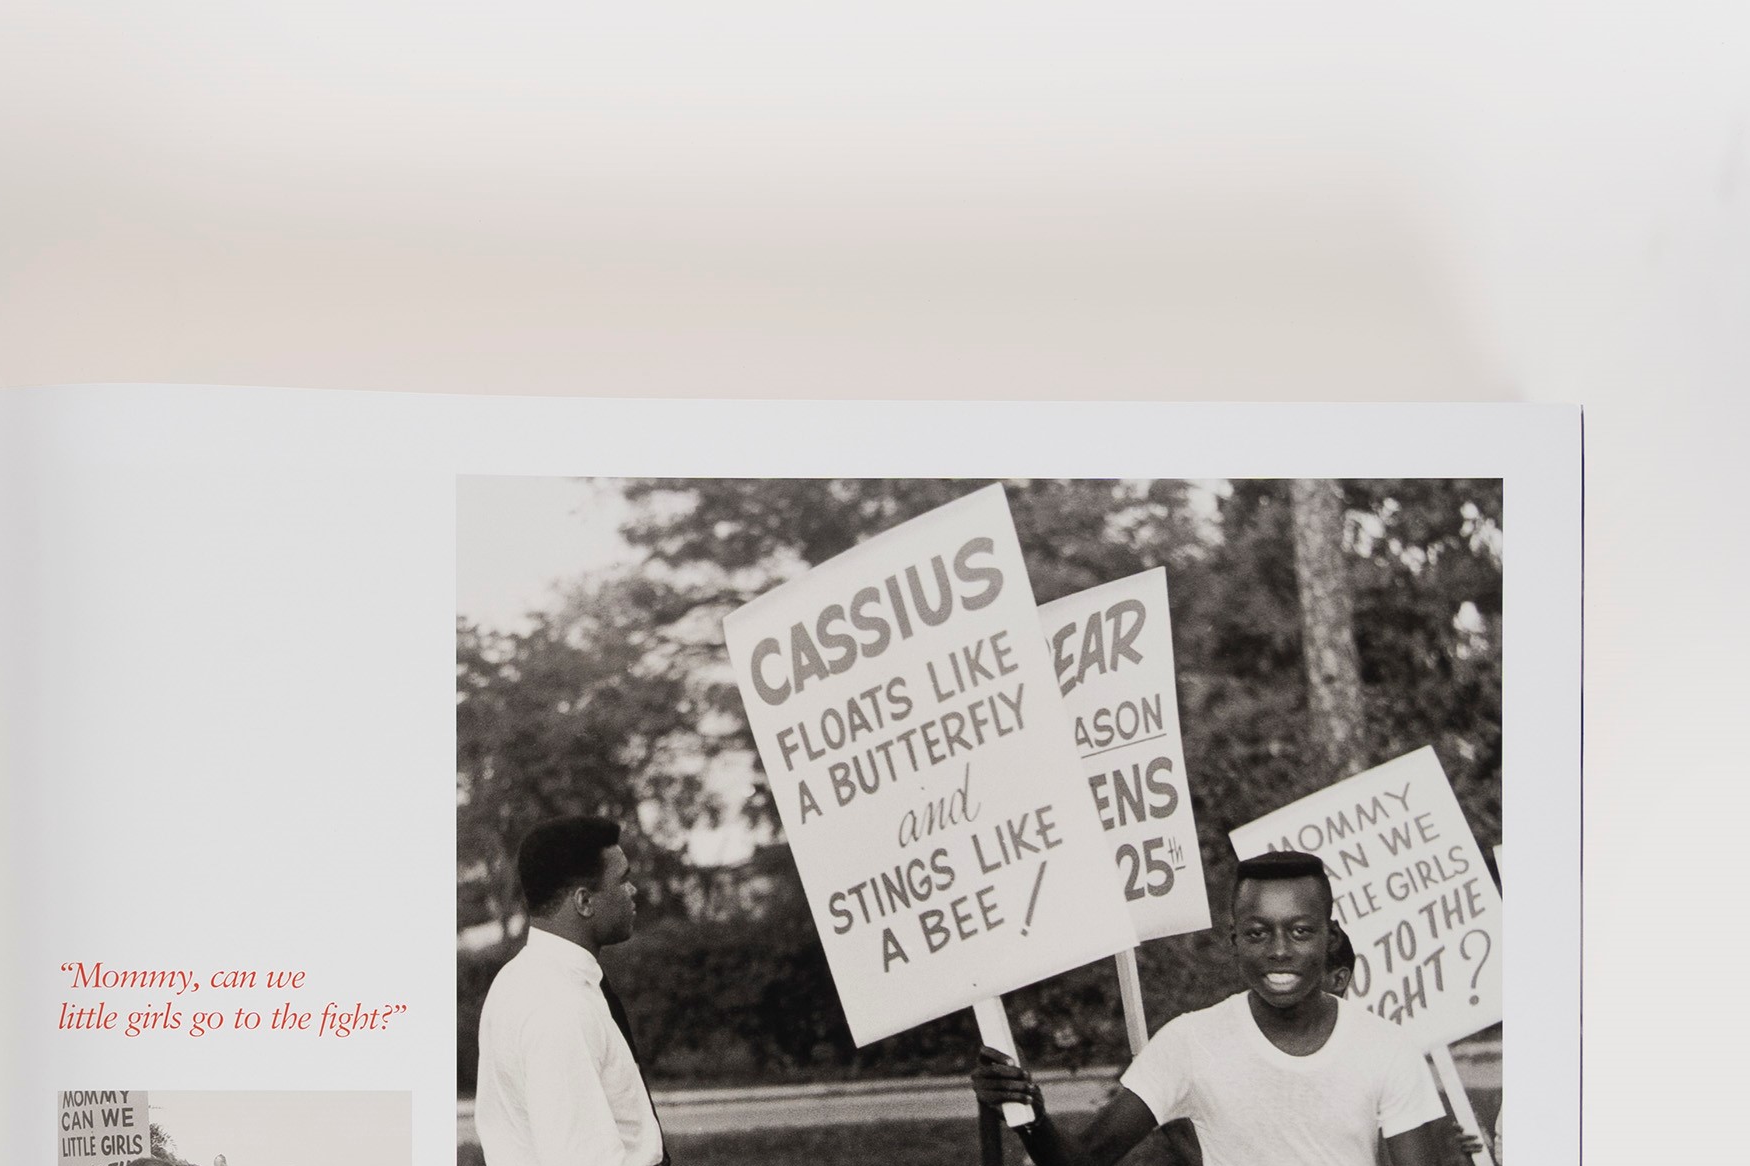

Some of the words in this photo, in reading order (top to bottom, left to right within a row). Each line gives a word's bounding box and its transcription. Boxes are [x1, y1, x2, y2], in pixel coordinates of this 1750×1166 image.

[751, 537, 1003, 706] CASSIUS
[1046, 599, 1146, 698] EAR
[775, 676, 913, 772] FLOATS
[926, 630, 1019, 703] LIKE
[797, 779, 823, 825] A
[828, 683, 1024, 807] BUTTERFLY
[898, 762, 981, 848] and
[1378, 812, 1440, 856] WE
[828, 848, 956, 935] STINGS
[971, 805, 1063, 875] LIKE
[1385, 845, 1469, 901] GIRLS
[882, 927, 910, 973] A
[1373, 920, 1416, 974] TO
[1418, 877, 1485, 939] THE
[60, 962, 200, 996] “Mommy,
[210, 970, 256, 988] can
[266, 971, 306, 989] we
[58, 1002, 118, 1030] little
[124, 1002, 182, 1037] girls
[189, 1012, 224, 1037] go
[234, 1008, 261, 1030] to
[271, 1002, 312, 1030] the
[61, 1110, 94, 1131] CAN
[101, 1108, 134, 1127] WE
[63, 1091, 129, 1109] MOMMY
[62, 1136, 96, 1157] LITTLE
[101, 1134, 143, 1156] GIRLS
